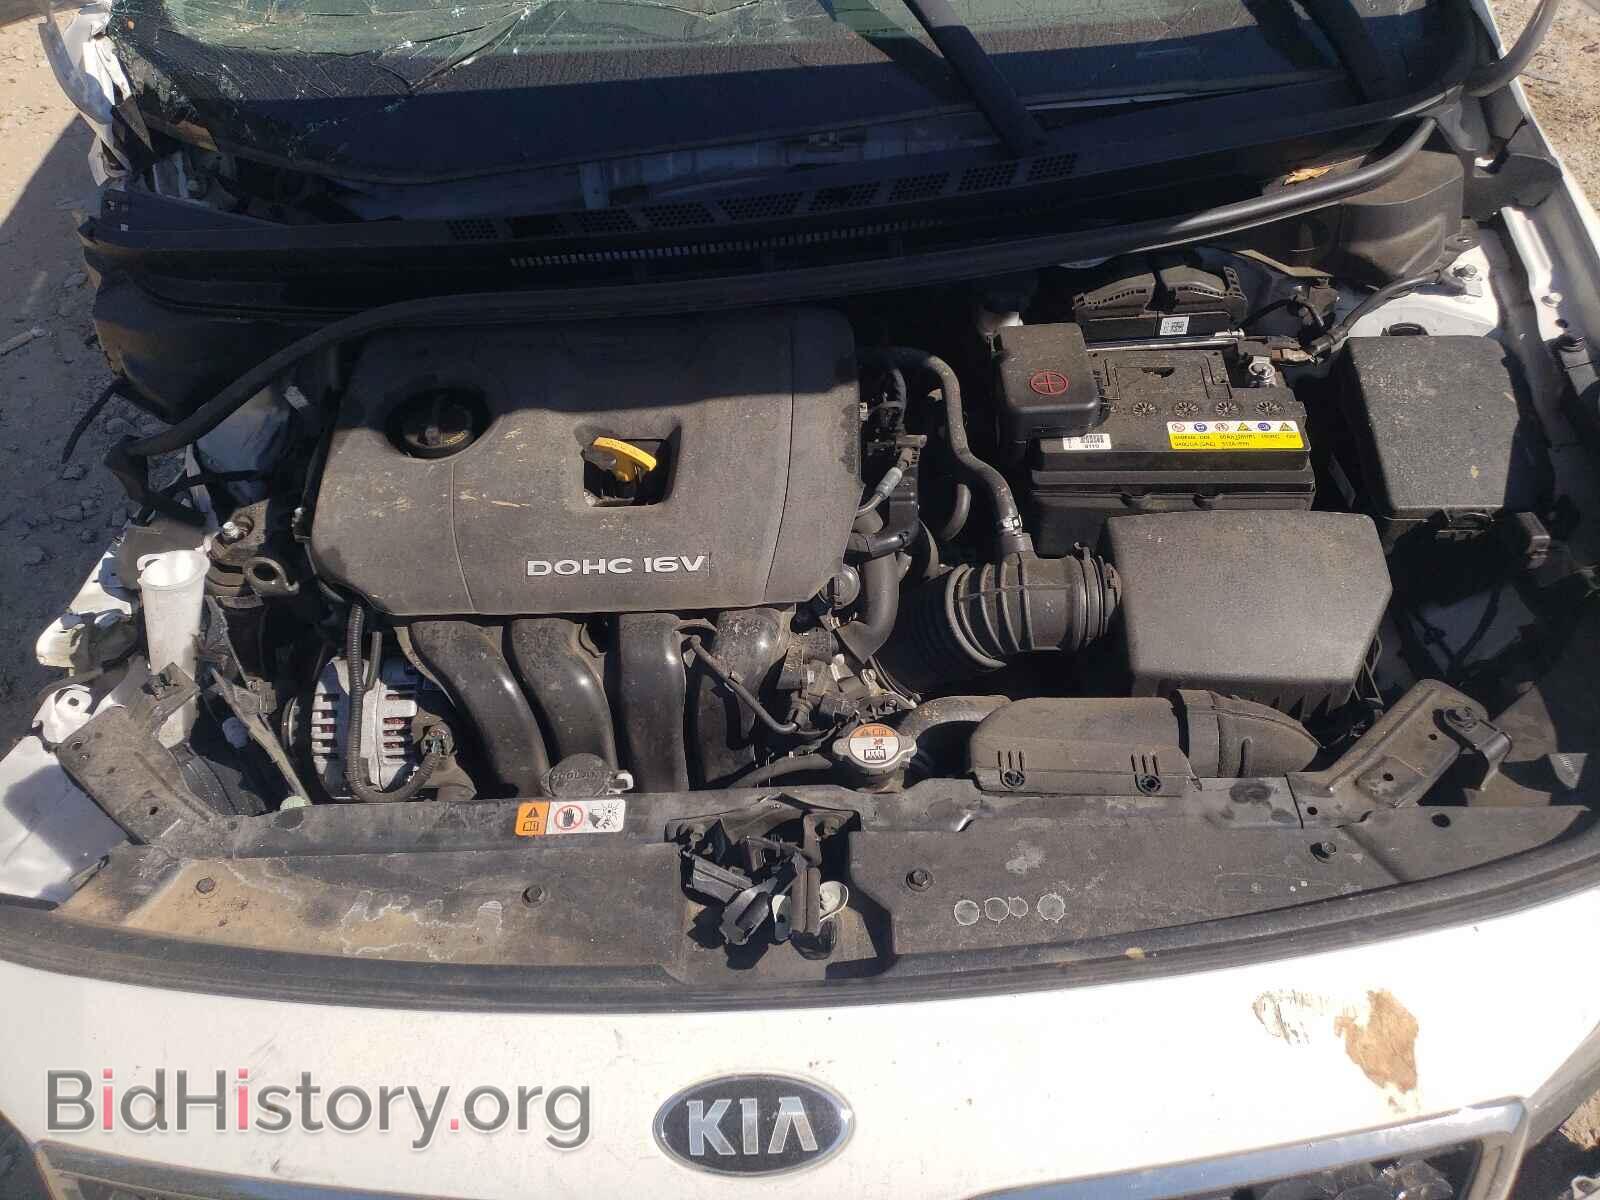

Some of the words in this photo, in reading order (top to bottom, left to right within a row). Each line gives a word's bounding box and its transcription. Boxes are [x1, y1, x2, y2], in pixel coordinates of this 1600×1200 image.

[527, 557, 633, 576] DOHC
[643, 555, 705, 573] 16V
[686, 1096, 819, 1156] KIA
